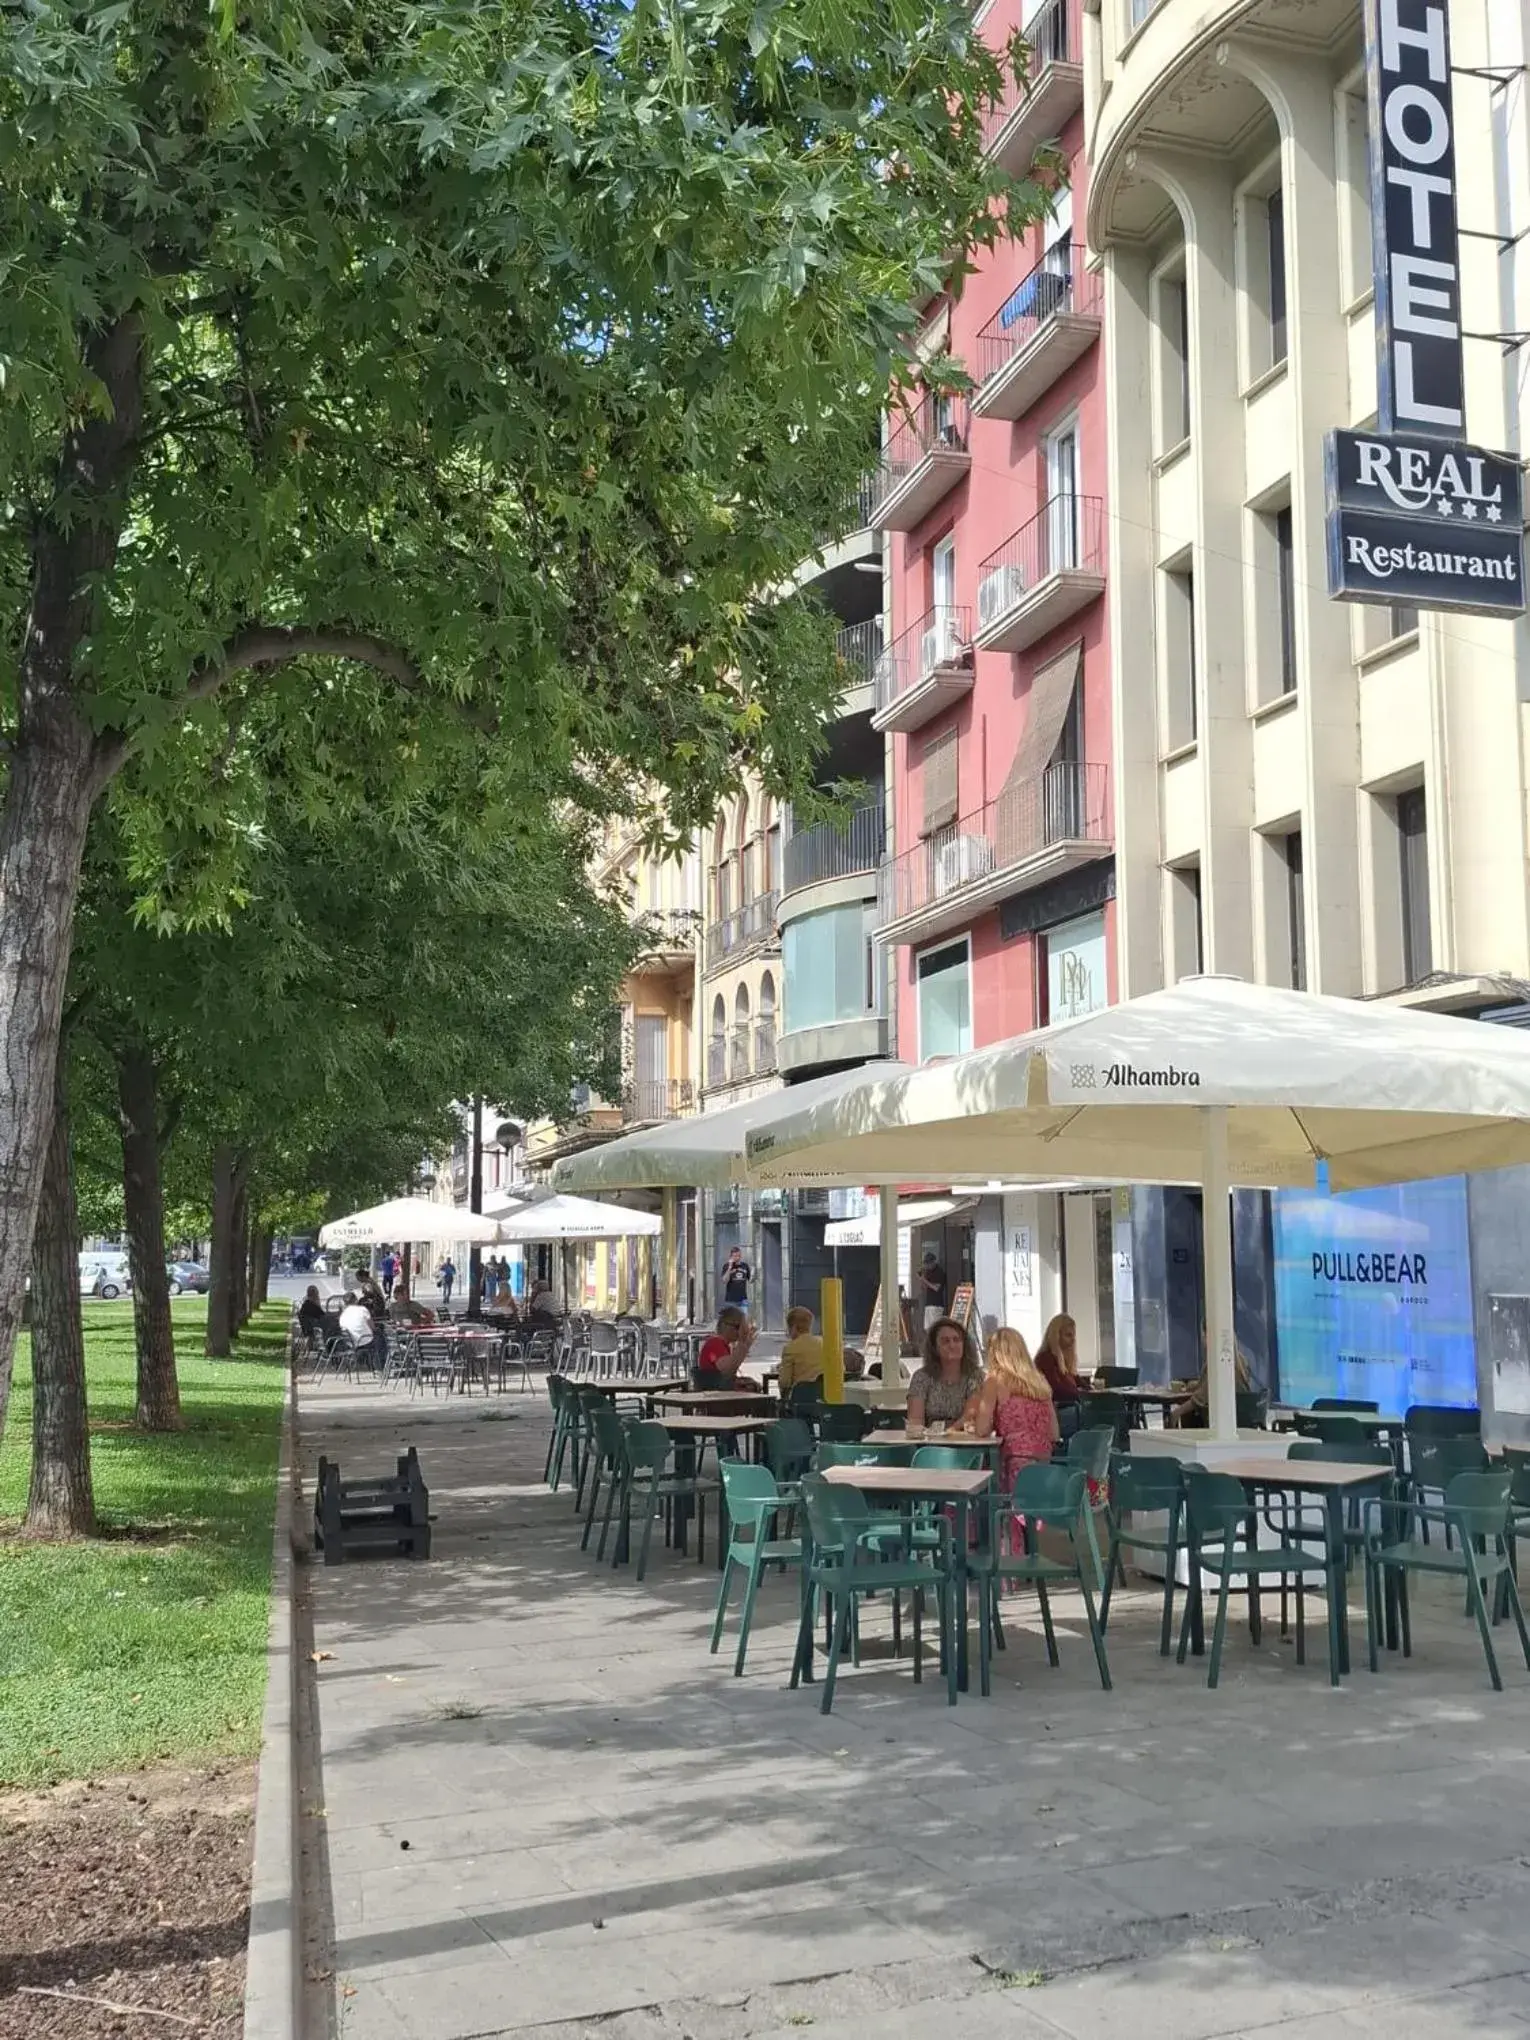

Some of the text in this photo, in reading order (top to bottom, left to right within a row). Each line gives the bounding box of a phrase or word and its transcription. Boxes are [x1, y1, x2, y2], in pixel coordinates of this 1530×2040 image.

[1381, 0, 1461, 428] HOTEL
[1355, 441, 1502, 510] REAL
[1347, 536, 1517, 581] Restaurant
[1102, 1063, 1201, 1089] Alhambra
[1312, 1252, 1428, 1284] PULL&BEAR
